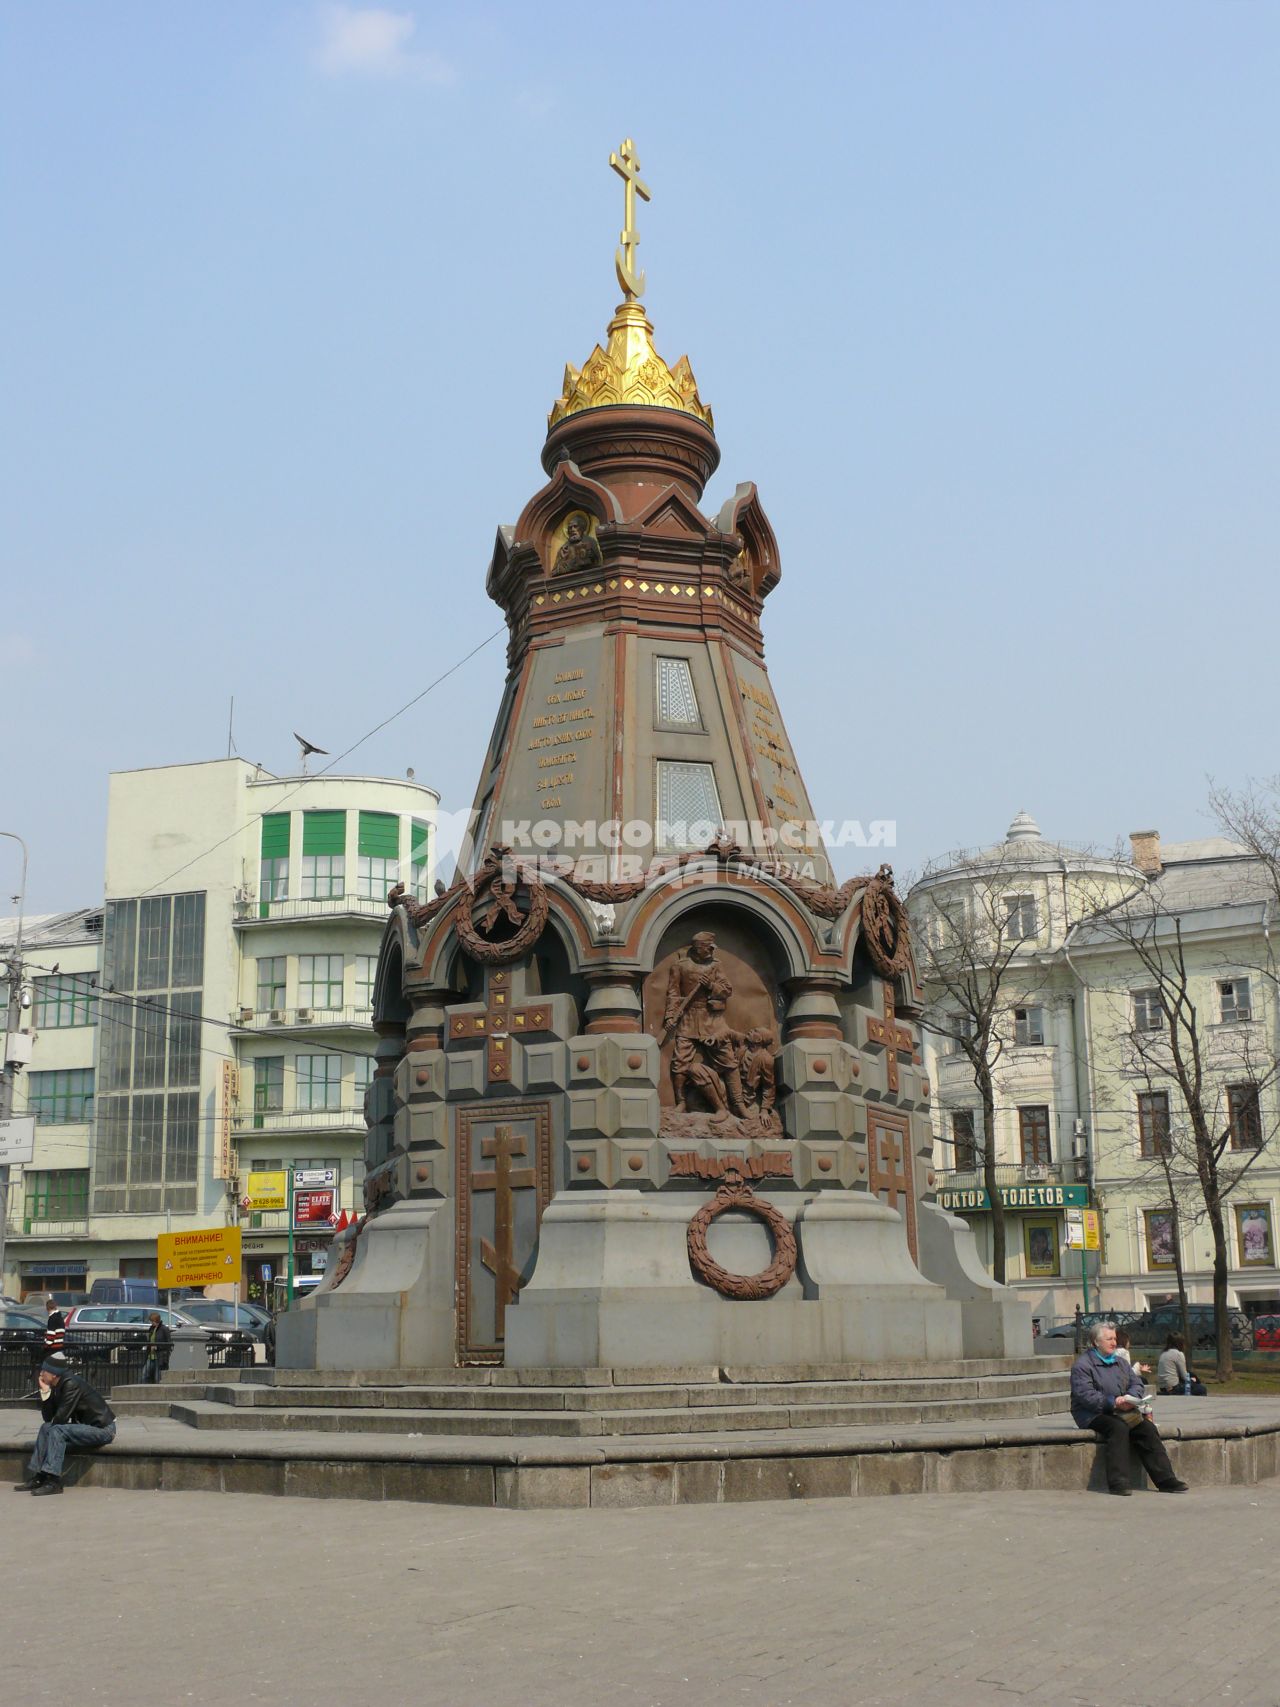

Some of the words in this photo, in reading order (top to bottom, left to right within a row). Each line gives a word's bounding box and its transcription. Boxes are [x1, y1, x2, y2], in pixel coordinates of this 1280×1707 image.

[998, 1187, 1064, 1206] ТОЛЕТОВ
[174, 1233, 223, 1246] ВНИМАНИЕ!
[176, 1271, 223, 1283] ОГРАНИЧЕНО
